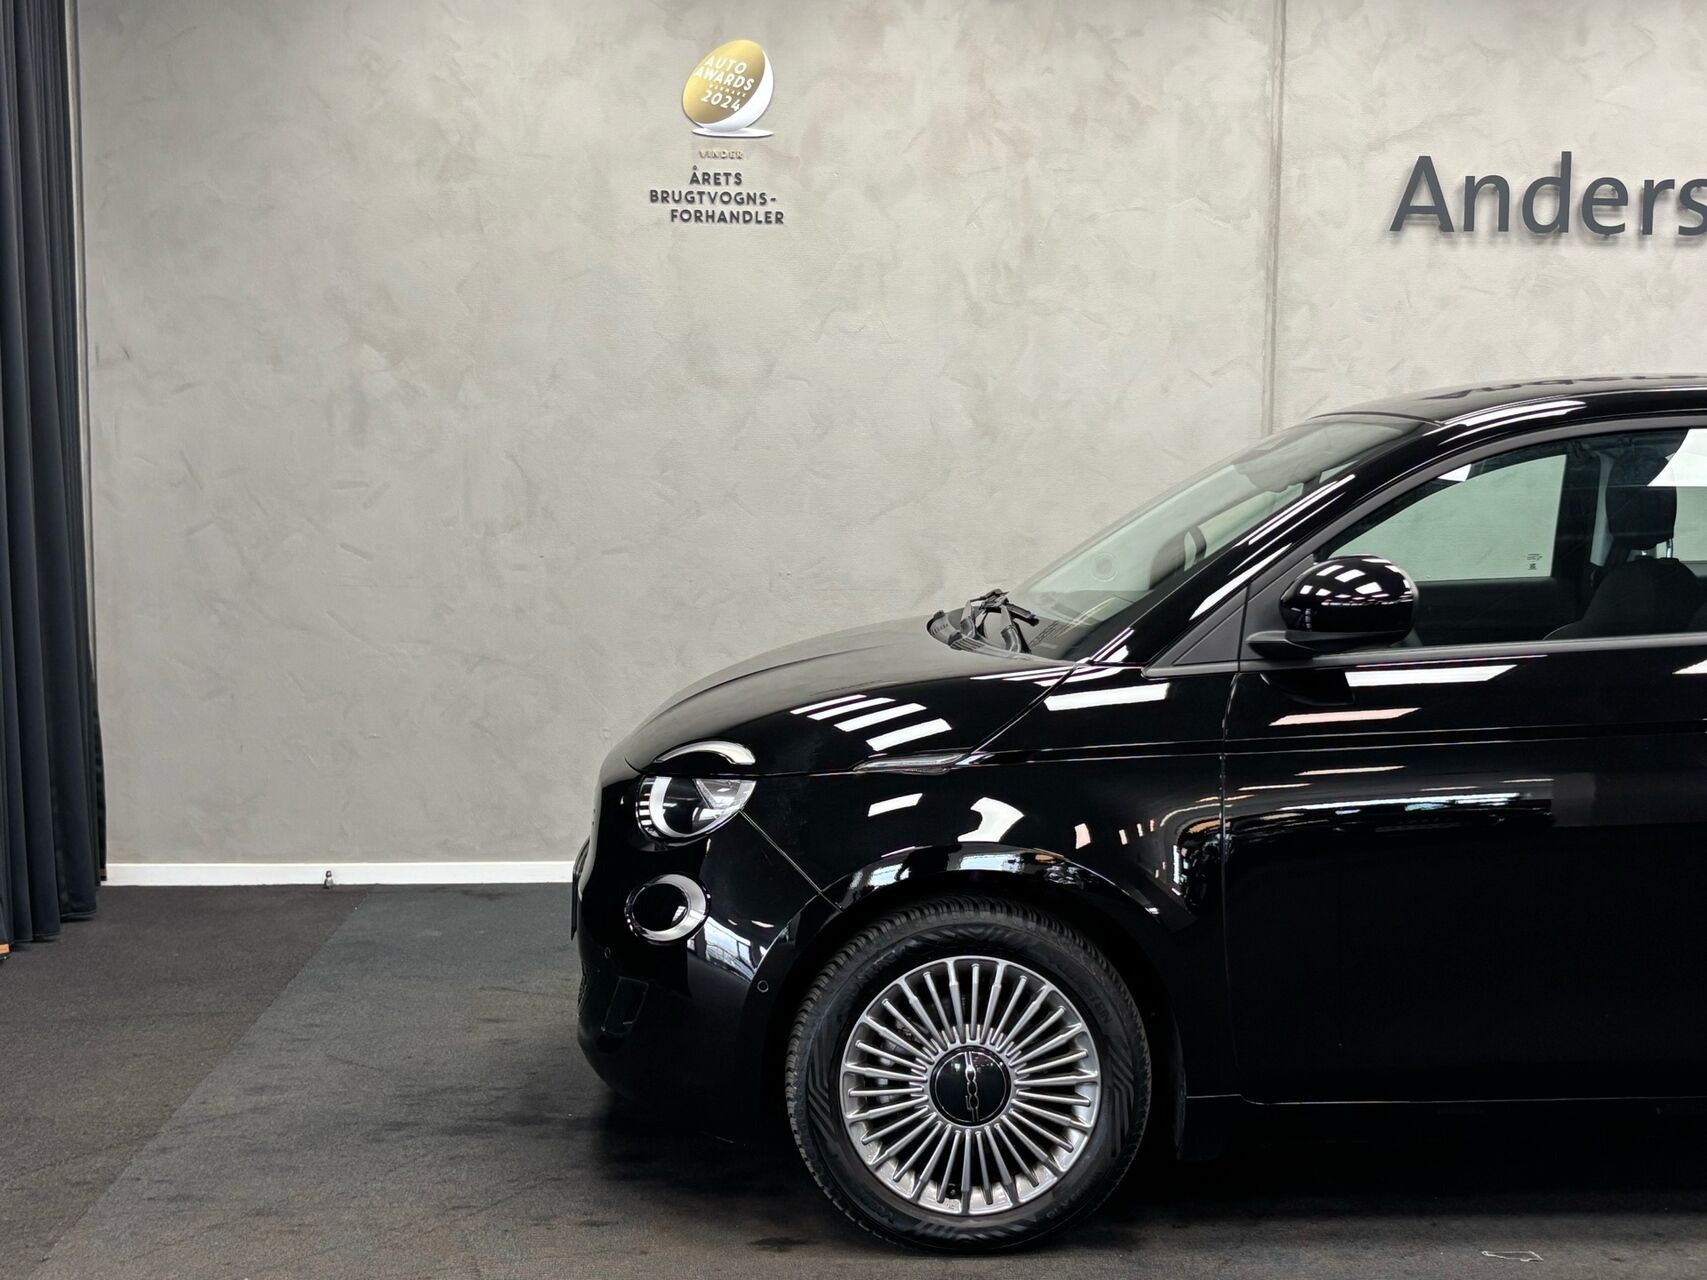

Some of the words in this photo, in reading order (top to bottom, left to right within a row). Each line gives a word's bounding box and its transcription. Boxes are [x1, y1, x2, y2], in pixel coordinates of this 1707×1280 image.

[704, 55, 747, 74] AUTO
[694, 66, 755, 91] AWARDS
[701, 89, 740, 112] 2024
[699, 148, 744, 160] VINDER
[689, 165, 743, 186] ÅRETS
[650, 189, 777, 206] BRUGTVOGNS-
[1390, 151, 1707, 236] Anders
[670, 209, 784, 225] FORHANDLER
